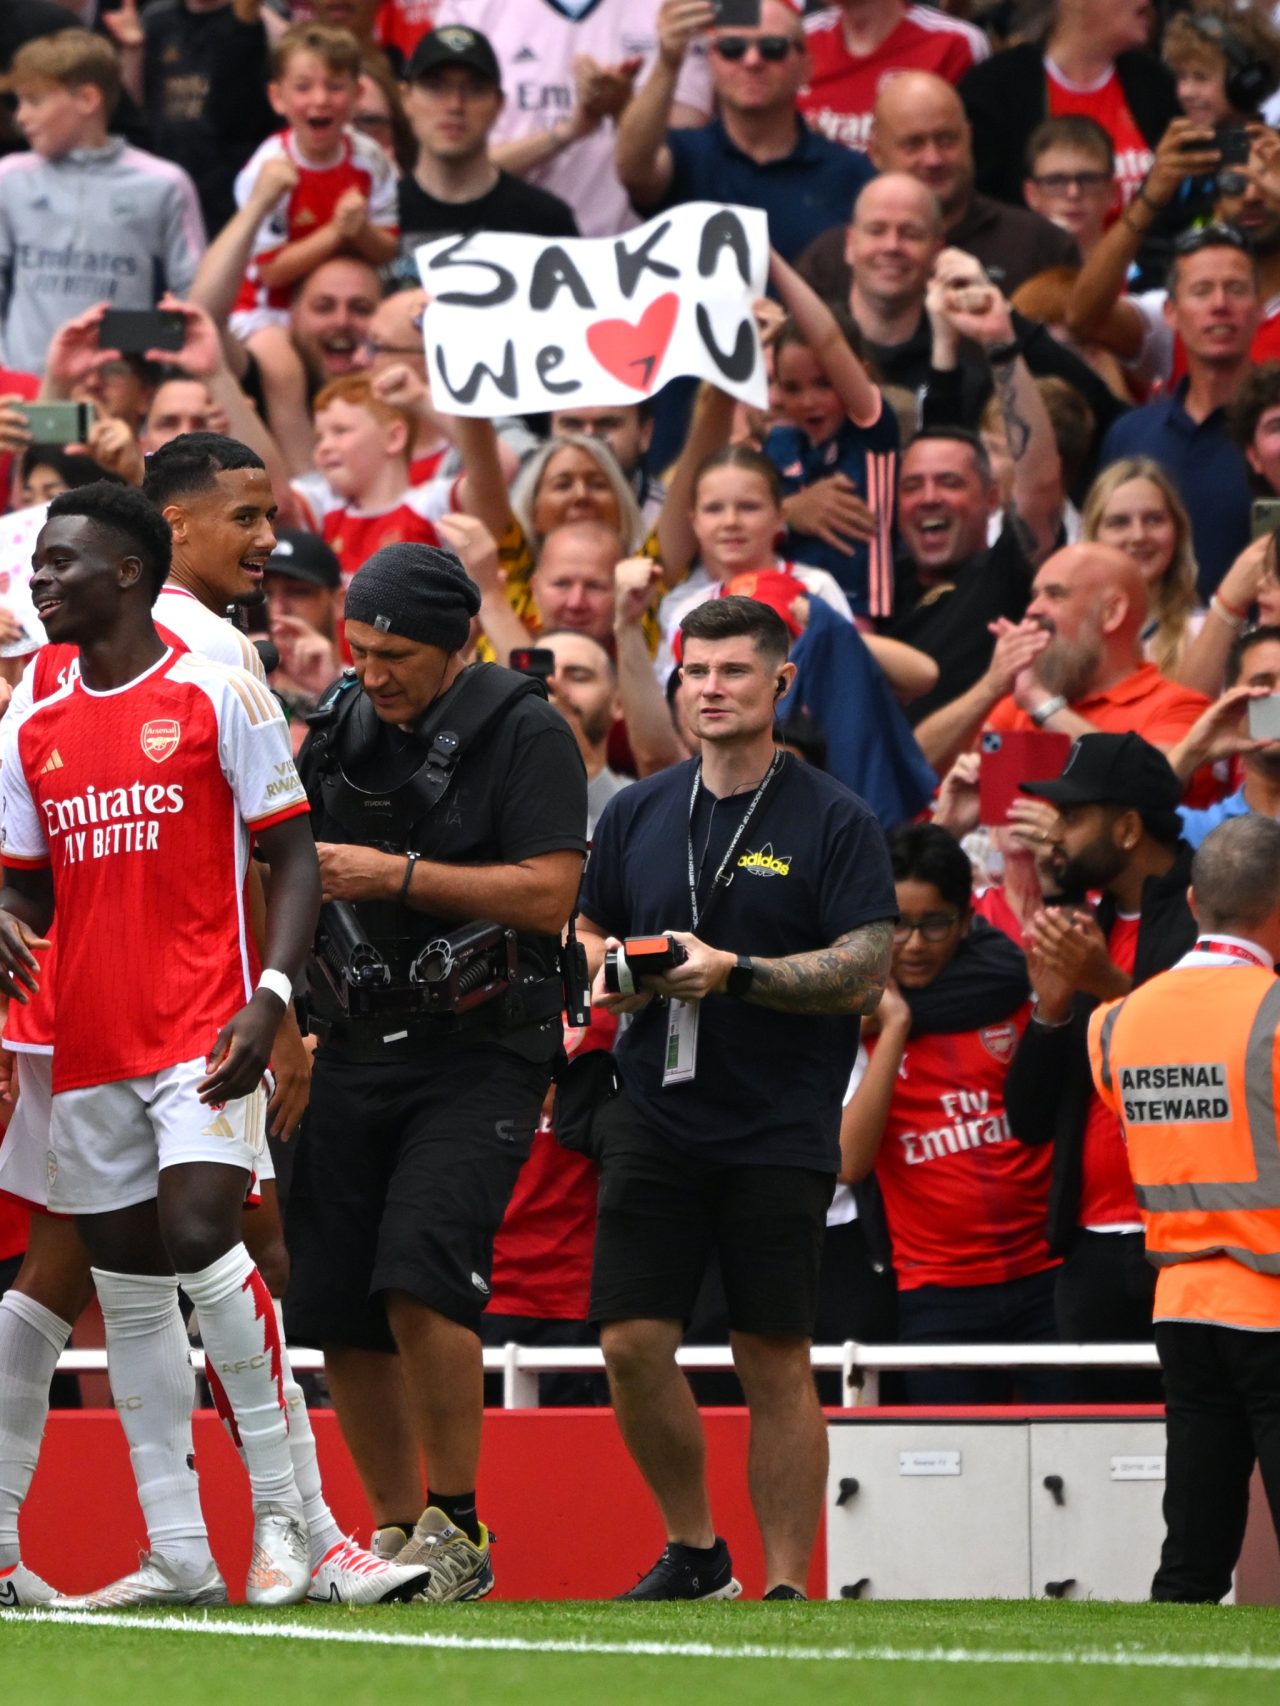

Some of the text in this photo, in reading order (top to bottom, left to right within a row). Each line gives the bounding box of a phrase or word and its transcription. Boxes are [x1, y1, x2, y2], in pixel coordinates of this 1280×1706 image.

[428, 210, 751, 310] SAKA
[436, 338, 582, 405] We
[273, 760, 295, 776] VIS
[41, 780, 184, 837] Emirates
[93, 820, 160, 859] BETTER
[737, 851, 789, 876] adidas
[1122, 1066, 1224, 1090] ARSENAL
[940, 1089, 989, 1118] Fly
[1124, 1098, 1229, 1122] STEWARD
[899, 1111, 1012, 1165] Emira
[222, 1355, 266, 1375] AFC
